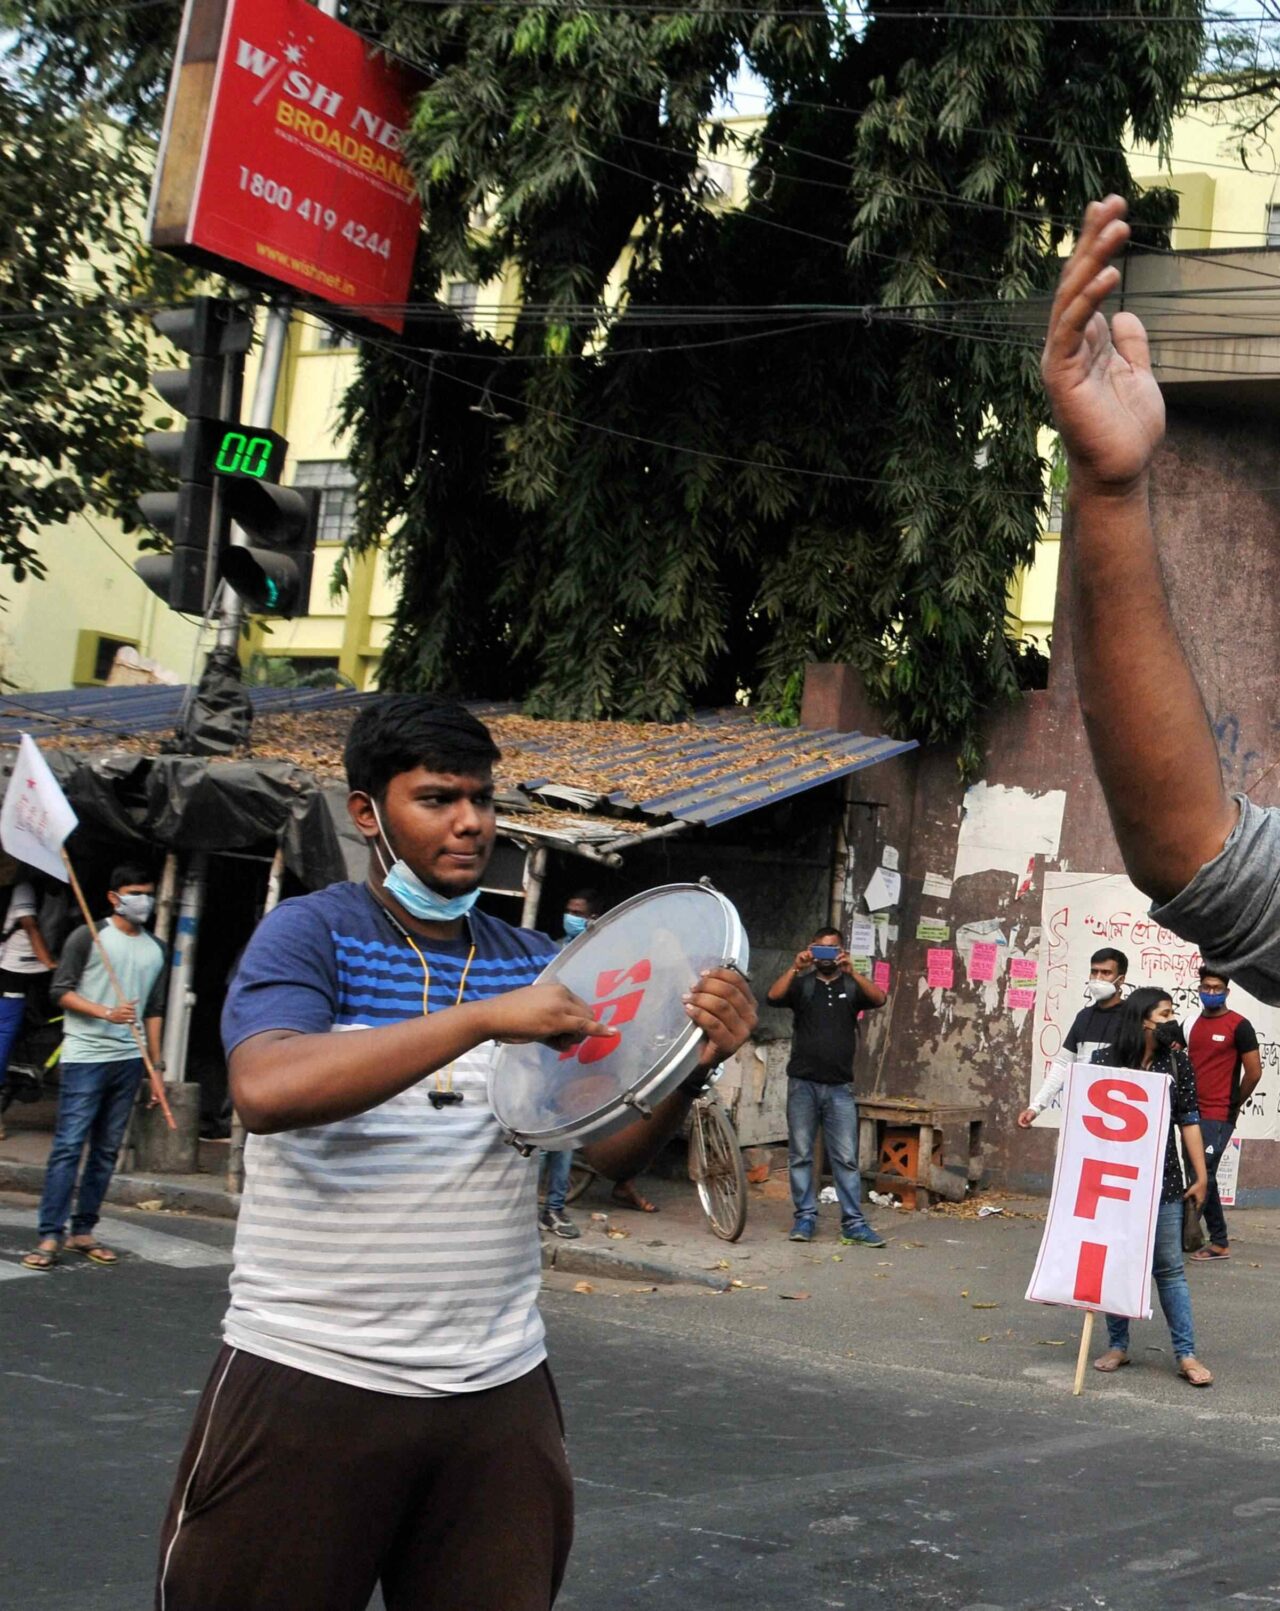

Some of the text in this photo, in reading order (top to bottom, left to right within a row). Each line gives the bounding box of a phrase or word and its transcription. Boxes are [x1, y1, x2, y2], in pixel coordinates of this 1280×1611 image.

[350, 105, 404, 152] NE
[239, 165, 294, 213] 1800
[296, 197, 338, 232] 419
[341, 219, 392, 261] 4244
[215, 431, 273, 478] 00
[1073, 1078, 1149, 1305] SFI
